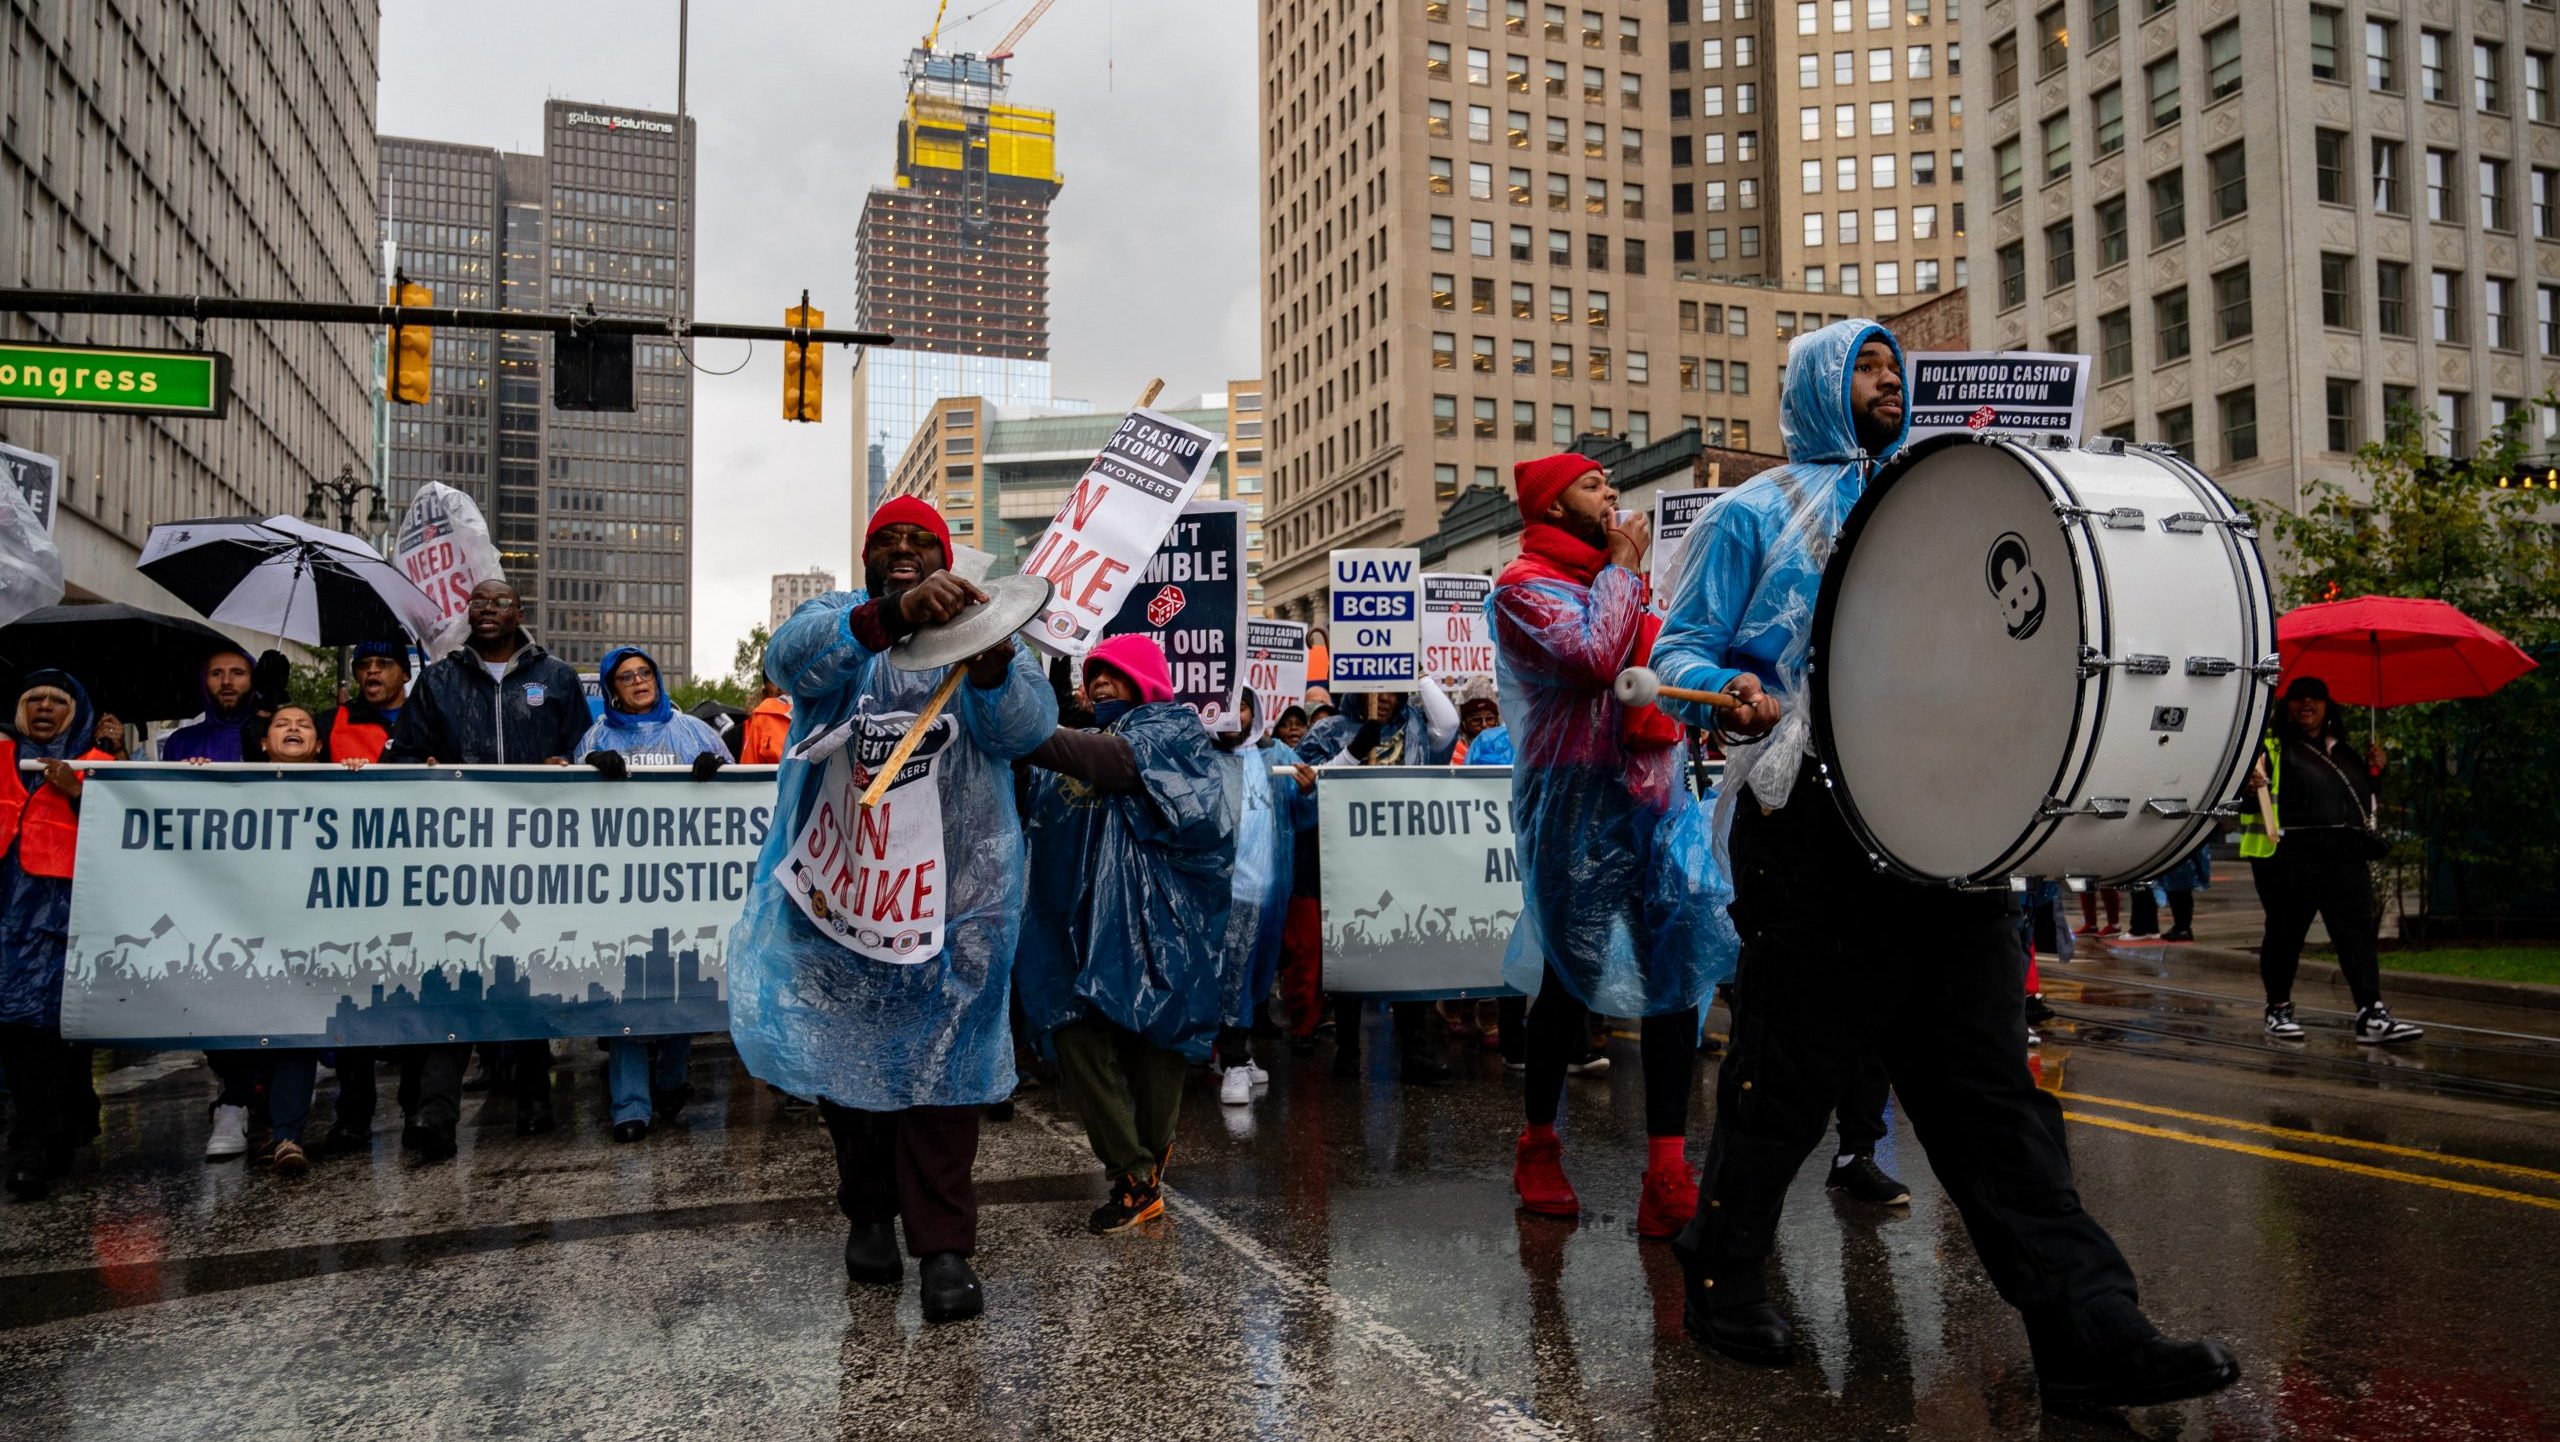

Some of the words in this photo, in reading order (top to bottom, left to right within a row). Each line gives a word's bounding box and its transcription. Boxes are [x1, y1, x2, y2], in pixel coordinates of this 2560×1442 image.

[0, 365, 157, 396] ongress
[1922, 365, 2008, 382] HOLLYWOOD
[2013, 365, 2070, 382] CASINO
[1937, 384, 1955, 400] AT
[1958, 383, 2049, 400] GREEKTOWN
[1915, 414, 1964, 424] CASINO
[2000, 415, 2067, 426] WORKERS
[1137, 425, 1199, 457] CASINO
[1103, 462, 1174, 498] WORKERS
[1674, 510, 1685, 521] AT
[406, 542, 454, 585] NEED
[1338, 560, 1412, 583] UAW
[1427, 580, 1463, 590] HOLLYWOOD
[1465, 581, 1489, 591] CASINO
[1435, 590, 1443, 599] AT
[1444, 590, 1480, 600] GREEKTOWN
[1343, 596, 1407, 617] BCBS
[1174, 629, 1225, 655] OUR
[1251, 635, 1294, 648] GREEKTOWN
[1276, 627, 1302, 639] CASINO
[1356, 629, 1391, 647] ON
[1448, 616, 1471, 642] ON
[1335, 657, 1412, 676] STRIKE
[1426, 645, 1493, 672] STRIKE
[1250, 663, 1278, 691] ON
[121, 806, 338, 850] DETROIT'S
[352, 807, 493, 849] MARCH
[507, 807, 579, 848] FOR
[843, 782, 891, 860] ON
[1348, 799, 1502, 837] DETROIT'S
[808, 800, 936, 922] STRIKE
[306, 865, 389, 909] AND
[403, 864, 609, 907] ECONOMIC
